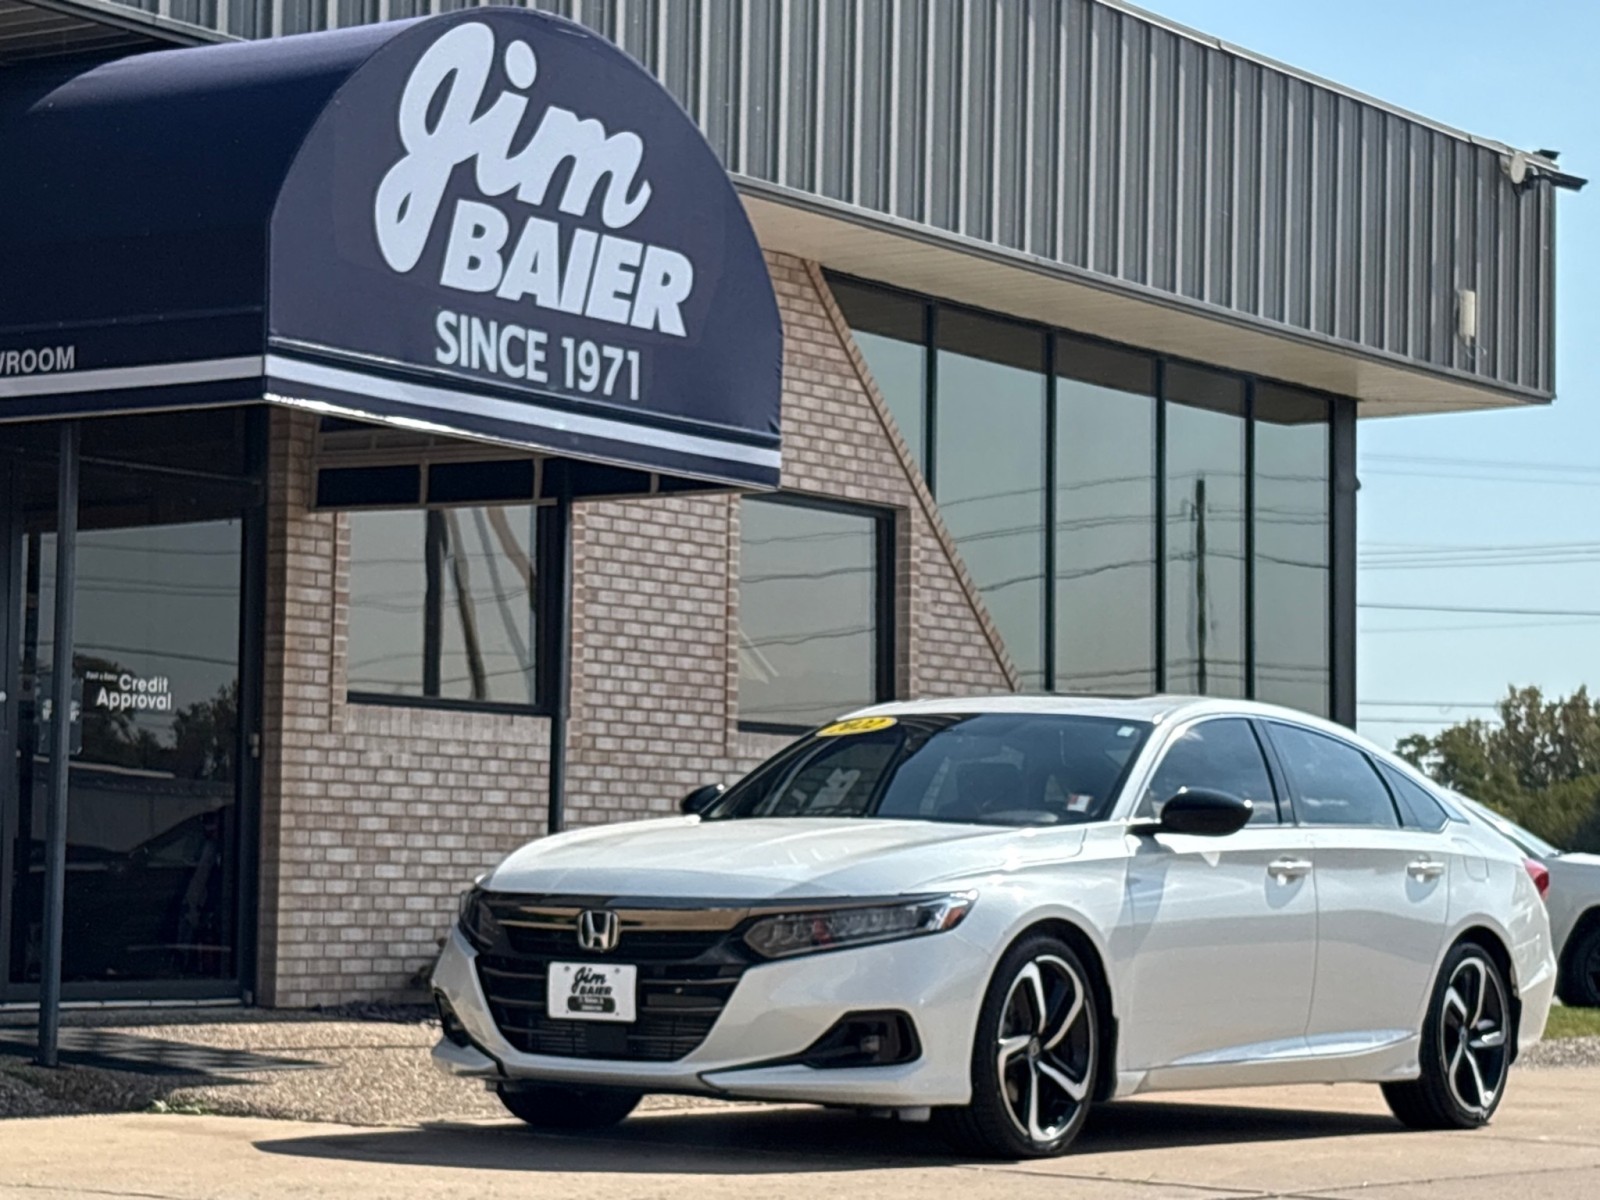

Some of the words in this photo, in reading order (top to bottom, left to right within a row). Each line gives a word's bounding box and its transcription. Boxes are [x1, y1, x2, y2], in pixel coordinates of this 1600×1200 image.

[375, 22, 651, 272] Jim
[440, 199, 693, 336] BAIER
[435, 310, 548, 383] SINCE
[561, 337, 639, 400] 1971
[96, 687, 172, 711] Approval
[119, 674, 169, 693] Credit
[579, 985, 613, 996] BAIER
